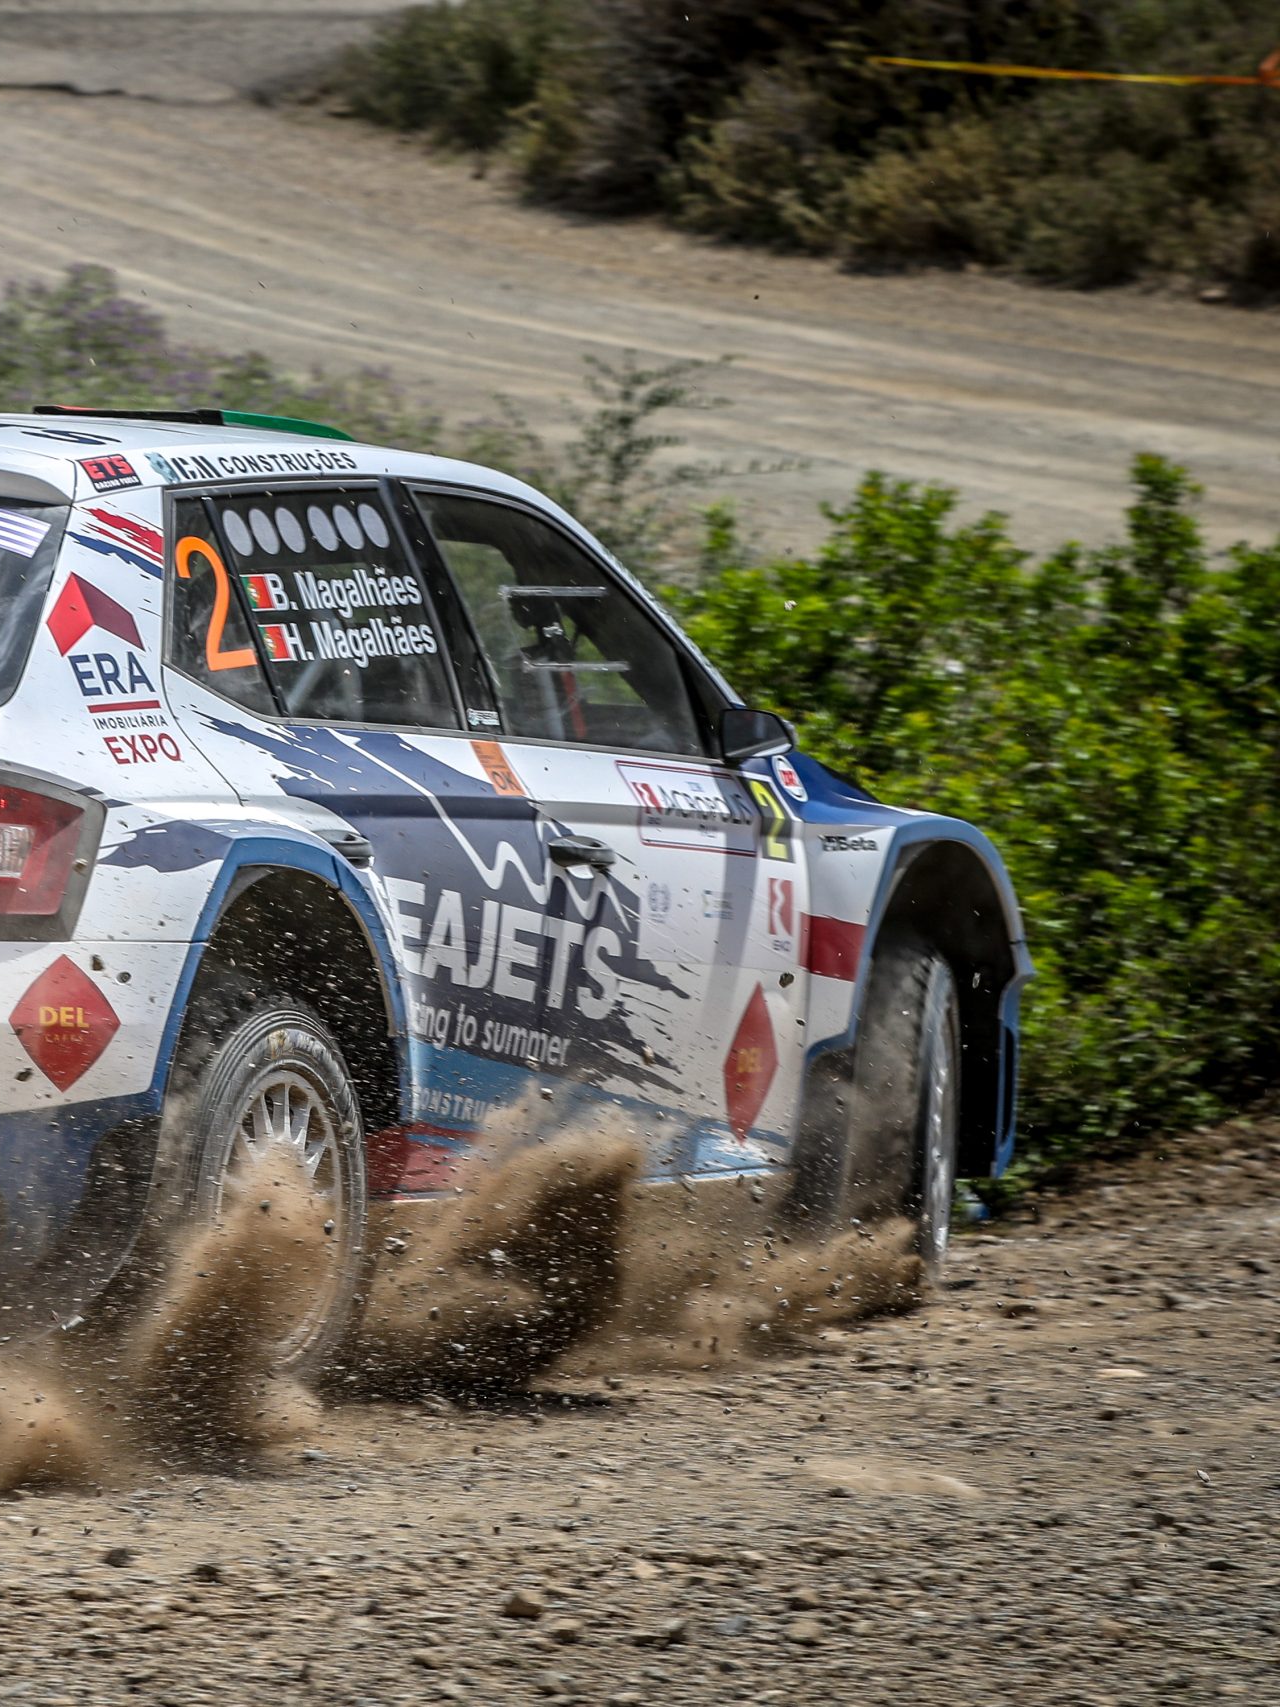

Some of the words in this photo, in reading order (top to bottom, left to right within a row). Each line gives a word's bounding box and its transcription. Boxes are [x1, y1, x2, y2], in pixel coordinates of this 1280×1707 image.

[81, 455, 135, 480] ETS
[219, 448, 358, 475] CONSTRUÇÕES
[175, 535, 257, 672] 2
[265, 573, 300, 612] B.
[293, 566, 422, 619] Magalhães
[280, 622, 316, 662] H.
[310, 614, 438, 669] Magalhães
[67, 651, 156, 697] ERA
[93, 711, 169, 730] IMOBILIÁRIA
[103, 732, 182, 765] EXPO
[748, 779, 789, 860] 2
[383, 875, 622, 1020] EAJETS
[39, 1006, 90, 1028] DEL
[454, 1002, 478, 1047] to
[481, 1018, 572, 1067] summer
